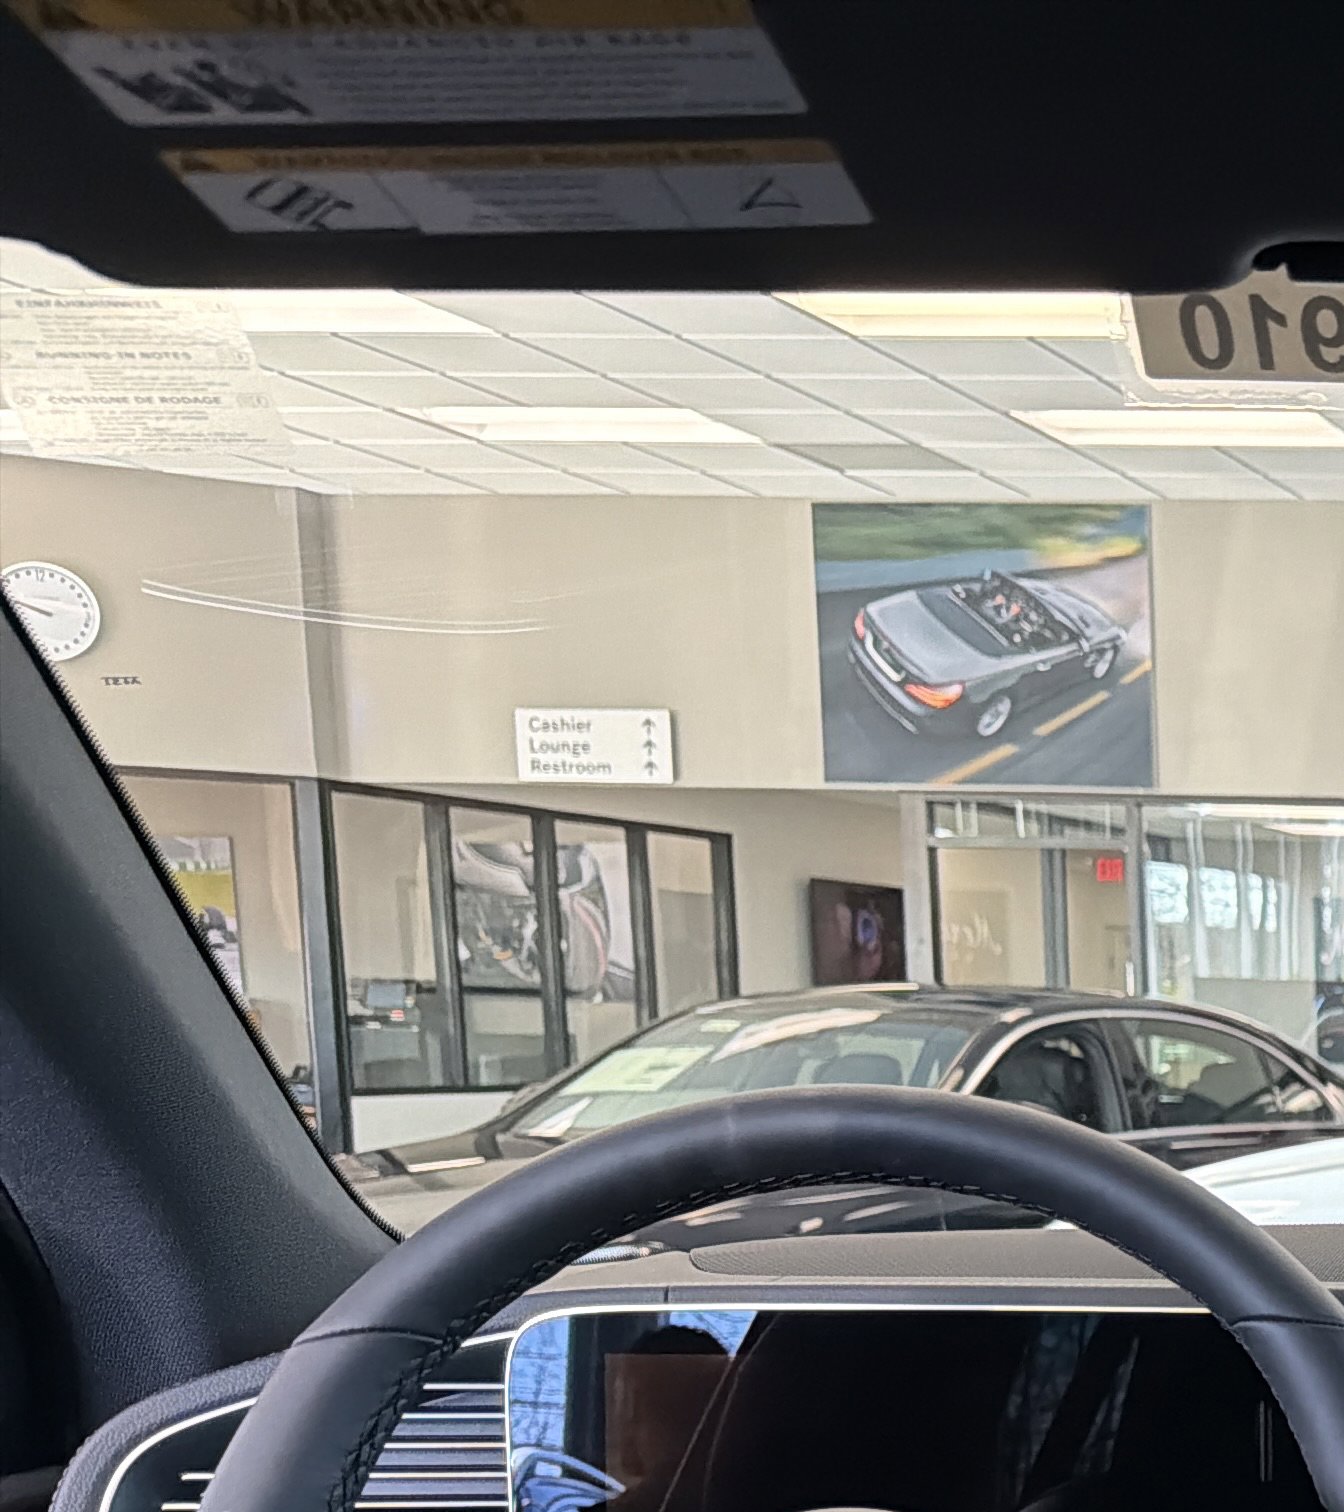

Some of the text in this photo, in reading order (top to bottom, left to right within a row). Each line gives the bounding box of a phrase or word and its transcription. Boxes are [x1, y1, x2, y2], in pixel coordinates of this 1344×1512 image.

[528, 715, 592, 733] Cashier
[528, 737, 591, 758] Lounge
[530, 759, 612, 775] Restroom
